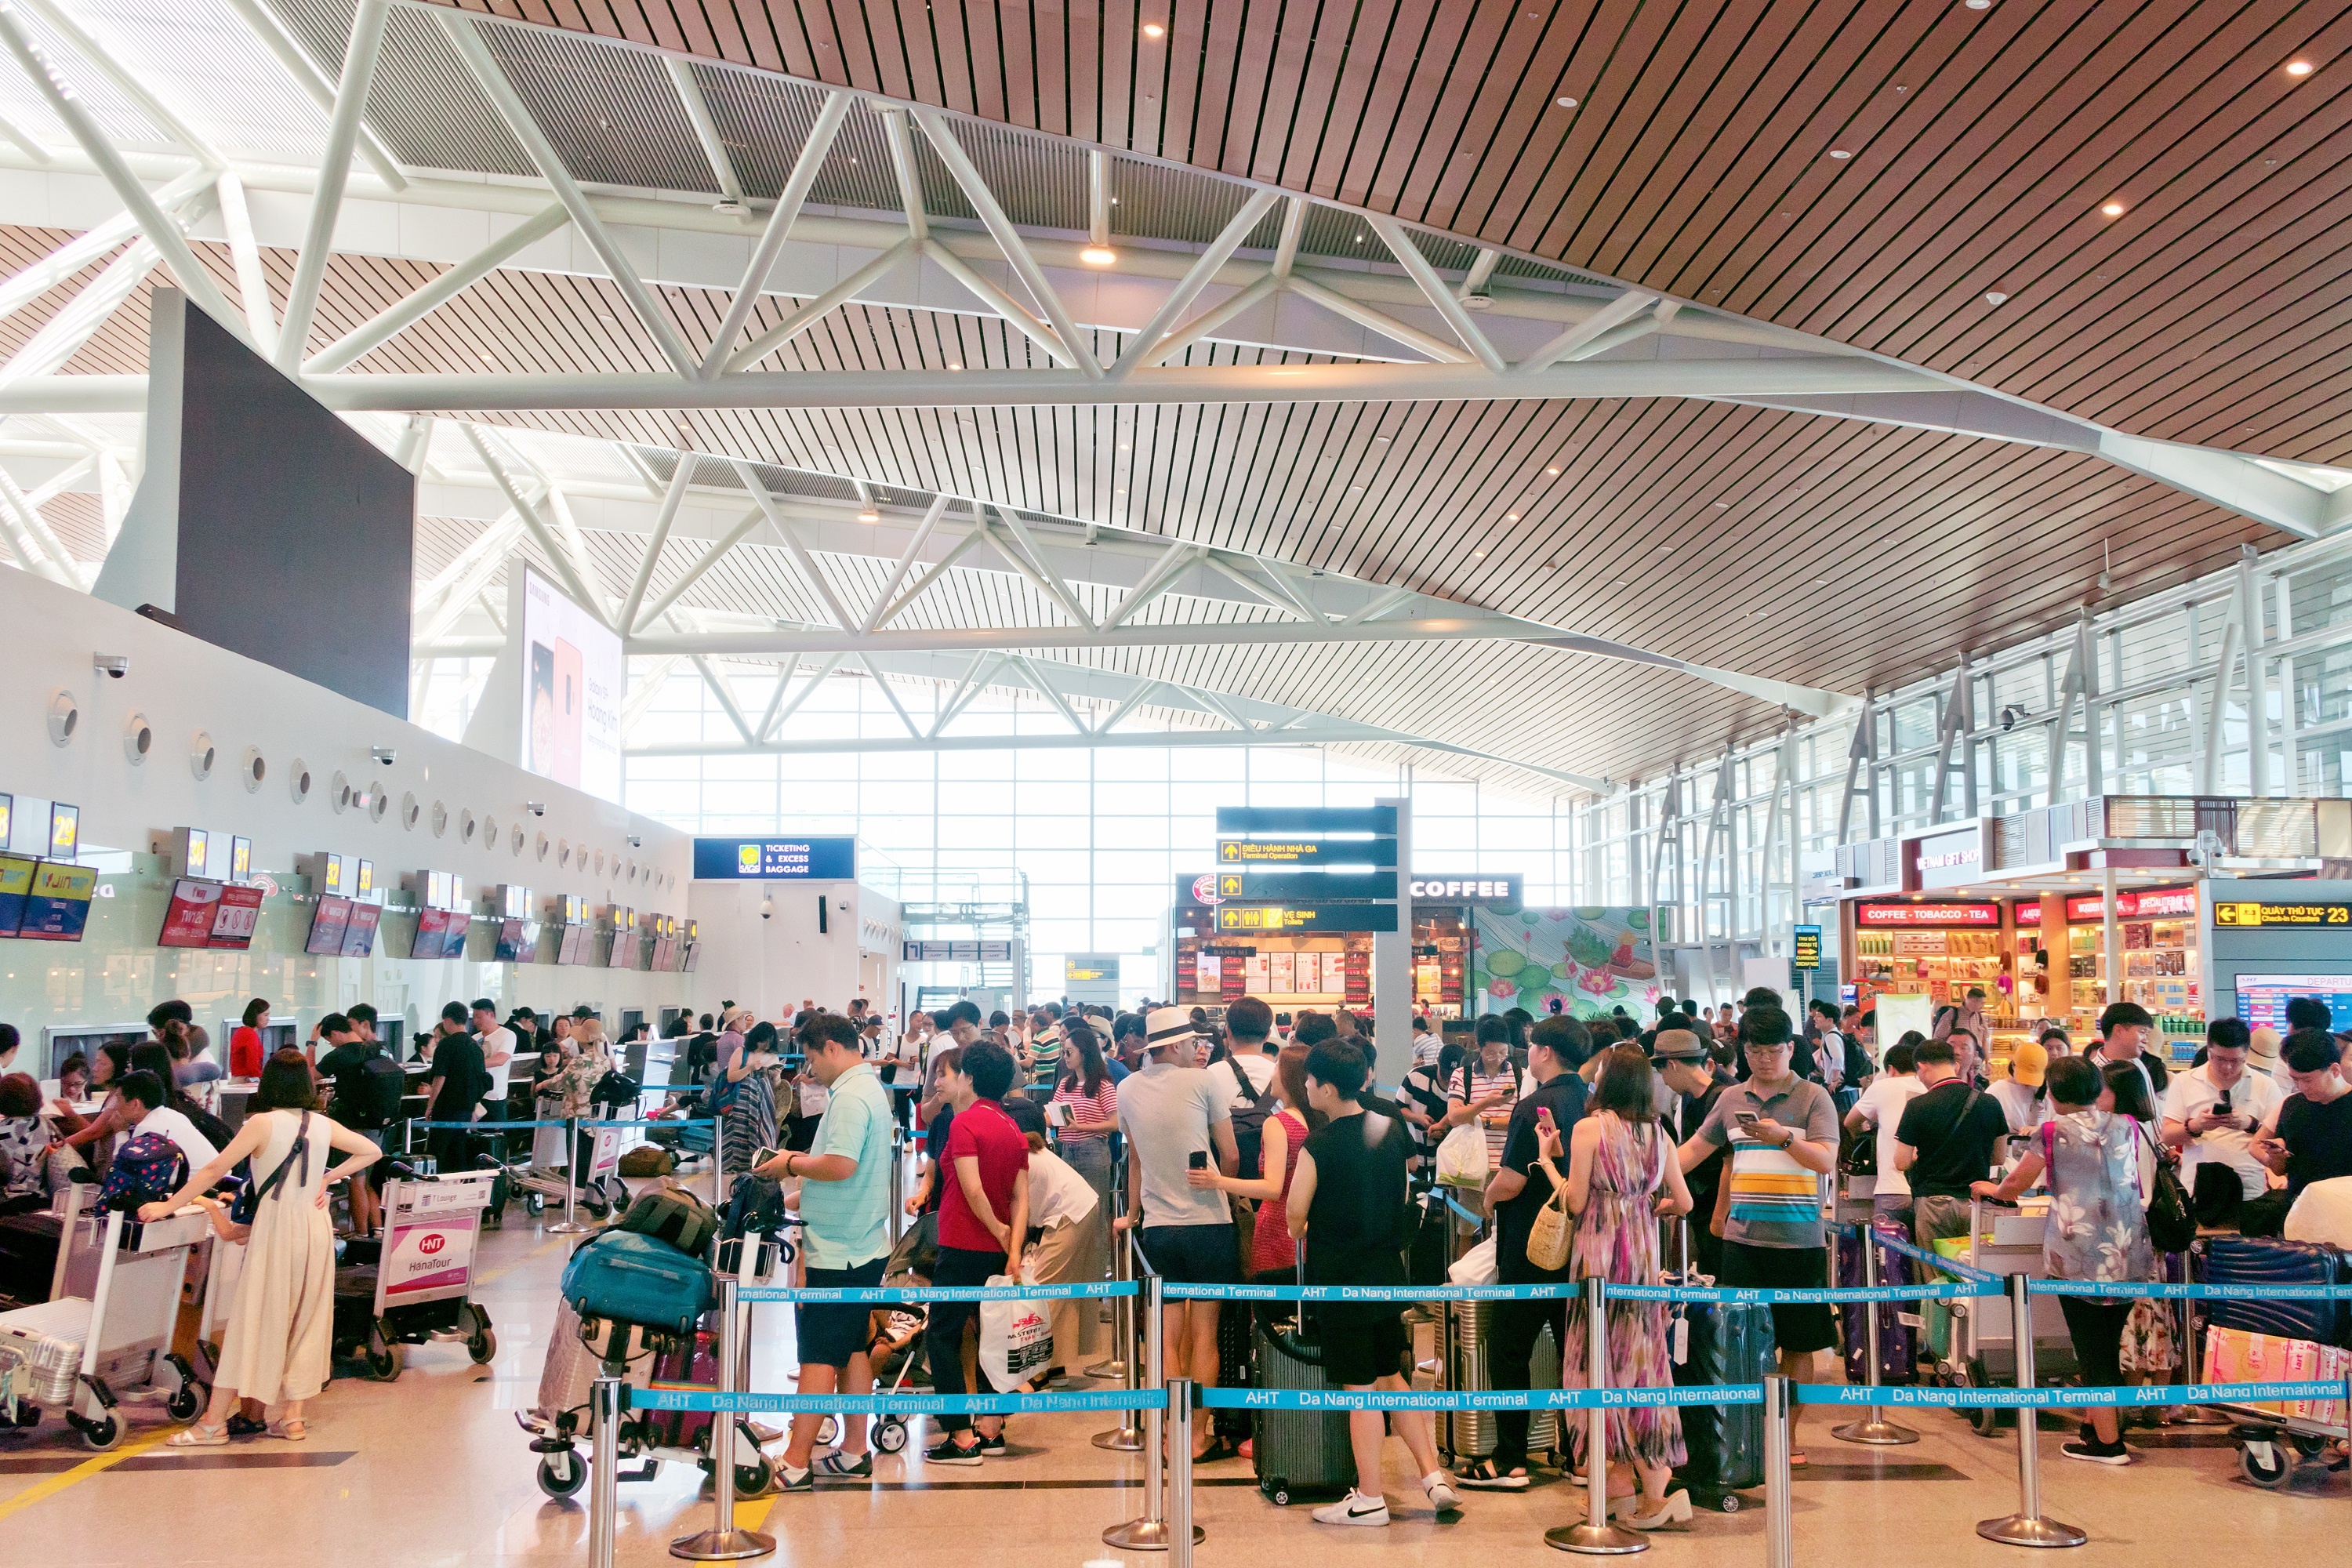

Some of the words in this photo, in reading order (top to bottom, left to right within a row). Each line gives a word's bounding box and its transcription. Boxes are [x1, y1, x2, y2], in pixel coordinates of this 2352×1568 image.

[529, 582, 550, 606] SAMSUNG
[589, 677, 602, 700] Galaxy
[608, 710, 618, 734] Kim
[53, 815, 75, 846] 29
[189, 839, 205, 866] 30
[1263, 844, 1286, 852] HÀNH
[1287, 844, 1304, 852] NHÀ
[235, 848, 249, 872] 31
[1916, 854, 1944, 871] VIETNAM
[1944, 851, 1960, 866] GIFT
[1961, 848, 1979, 864] SHOP
[327, 862, 339, 885] 32
[359, 868, 371, 891] 33
[1410, 881, 1508, 897] COFFEE
[1867, 910, 1906, 919] COFFEE
[1913, 909, 1962, 919] TOBACCO
[1969, 910, 1988, 919] TEA
[2327, 907, 2349, 923] 23
[437, 1194, 457, 1203] Lounge
[421, 1237, 444, 1250] HNT
[409, 1258, 452, 1272] HanaTour
[793, 1290, 842, 1300] Terminal
[860, 1290, 886, 1299] AHT
[901, 1289, 917, 1300] Da
[920, 1289, 949, 1301] Nang
[952, 1288, 1020, 1299] International
[1023, 1286, 1072, 1298] Terminal
[1086, 1284, 1112, 1294] AHT
[1162, 1286, 1225, 1297] nternational
[1227, 1287, 1276, 1298] Terminal
[1301, 1287, 1328, 1298] AHT
[1342, 1287, 1359, 1298] Da
[1361, 1287, 1391, 1300] Nang
[1393, 1287, 1463, 1298] International
[1465, 1287, 1515, 1298] Terminal
[1530, 1287, 1556, 1297] AHT
[1606, 1287, 1670, 1298] nternational
[1674, 1289, 1721, 1299] Terminal
[1736, 1290, 1760, 1300] AHT
[1774, 1290, 1790, 1300] Da
[1792, 1290, 1822, 1301] Nang
[1824, 1289, 1890, 1300] International
[1893, 1287, 1940, 1298] Terminal
[1954, 1284, 1979, 1294] AHT
[2030, 1282, 2095, 1294] nternational
[2098, 1284, 2147, 1295] Terminal
[2164, 1285, 2190, 1295] AHT
[2205, 1286, 2221, 1295] Da
[2223, 1286, 2254, 1298] Nang
[2256, 1286, 2326, 1297] International
[656, 1394, 692, 1407] AHT
[712, 1395, 733, 1409] Da
[737, 1396, 778, 1411] Nang
[781, 1396, 874, 1411] International
[878, 1397, 945, 1410] Terminal
[964, 1397, 999, 1410] AHT
[1021, 1396, 1043, 1410] Da
[1245, 1391, 1279, 1404] AHT
[1299, 1392, 1320, 1405] Da
[1324, 1392, 1364, 1409] Nang
[1367, 1393, 1459, 1407] International
[1463, 1392, 1528, 1406] Terminal
[1548, 1391, 1581, 1404] AHT
[1602, 1390, 1623, 1403] Da
[1626, 1390, 1665, 1405] Nang
[1668, 1386, 1760, 1403] International
[1840, 1388, 1874, 1401] AHT
[1893, 1388, 1914, 1402] Da
[1918, 1390, 1956, 1406] Nang
[1959, 1390, 2049, 1404] International
[2052, 1389, 2116, 1403] Terminal
[2135, 1388, 2168, 1401] AHT
[2187, 1386, 2209, 1400] Da
[2253, 1382, 2343, 1398] International
